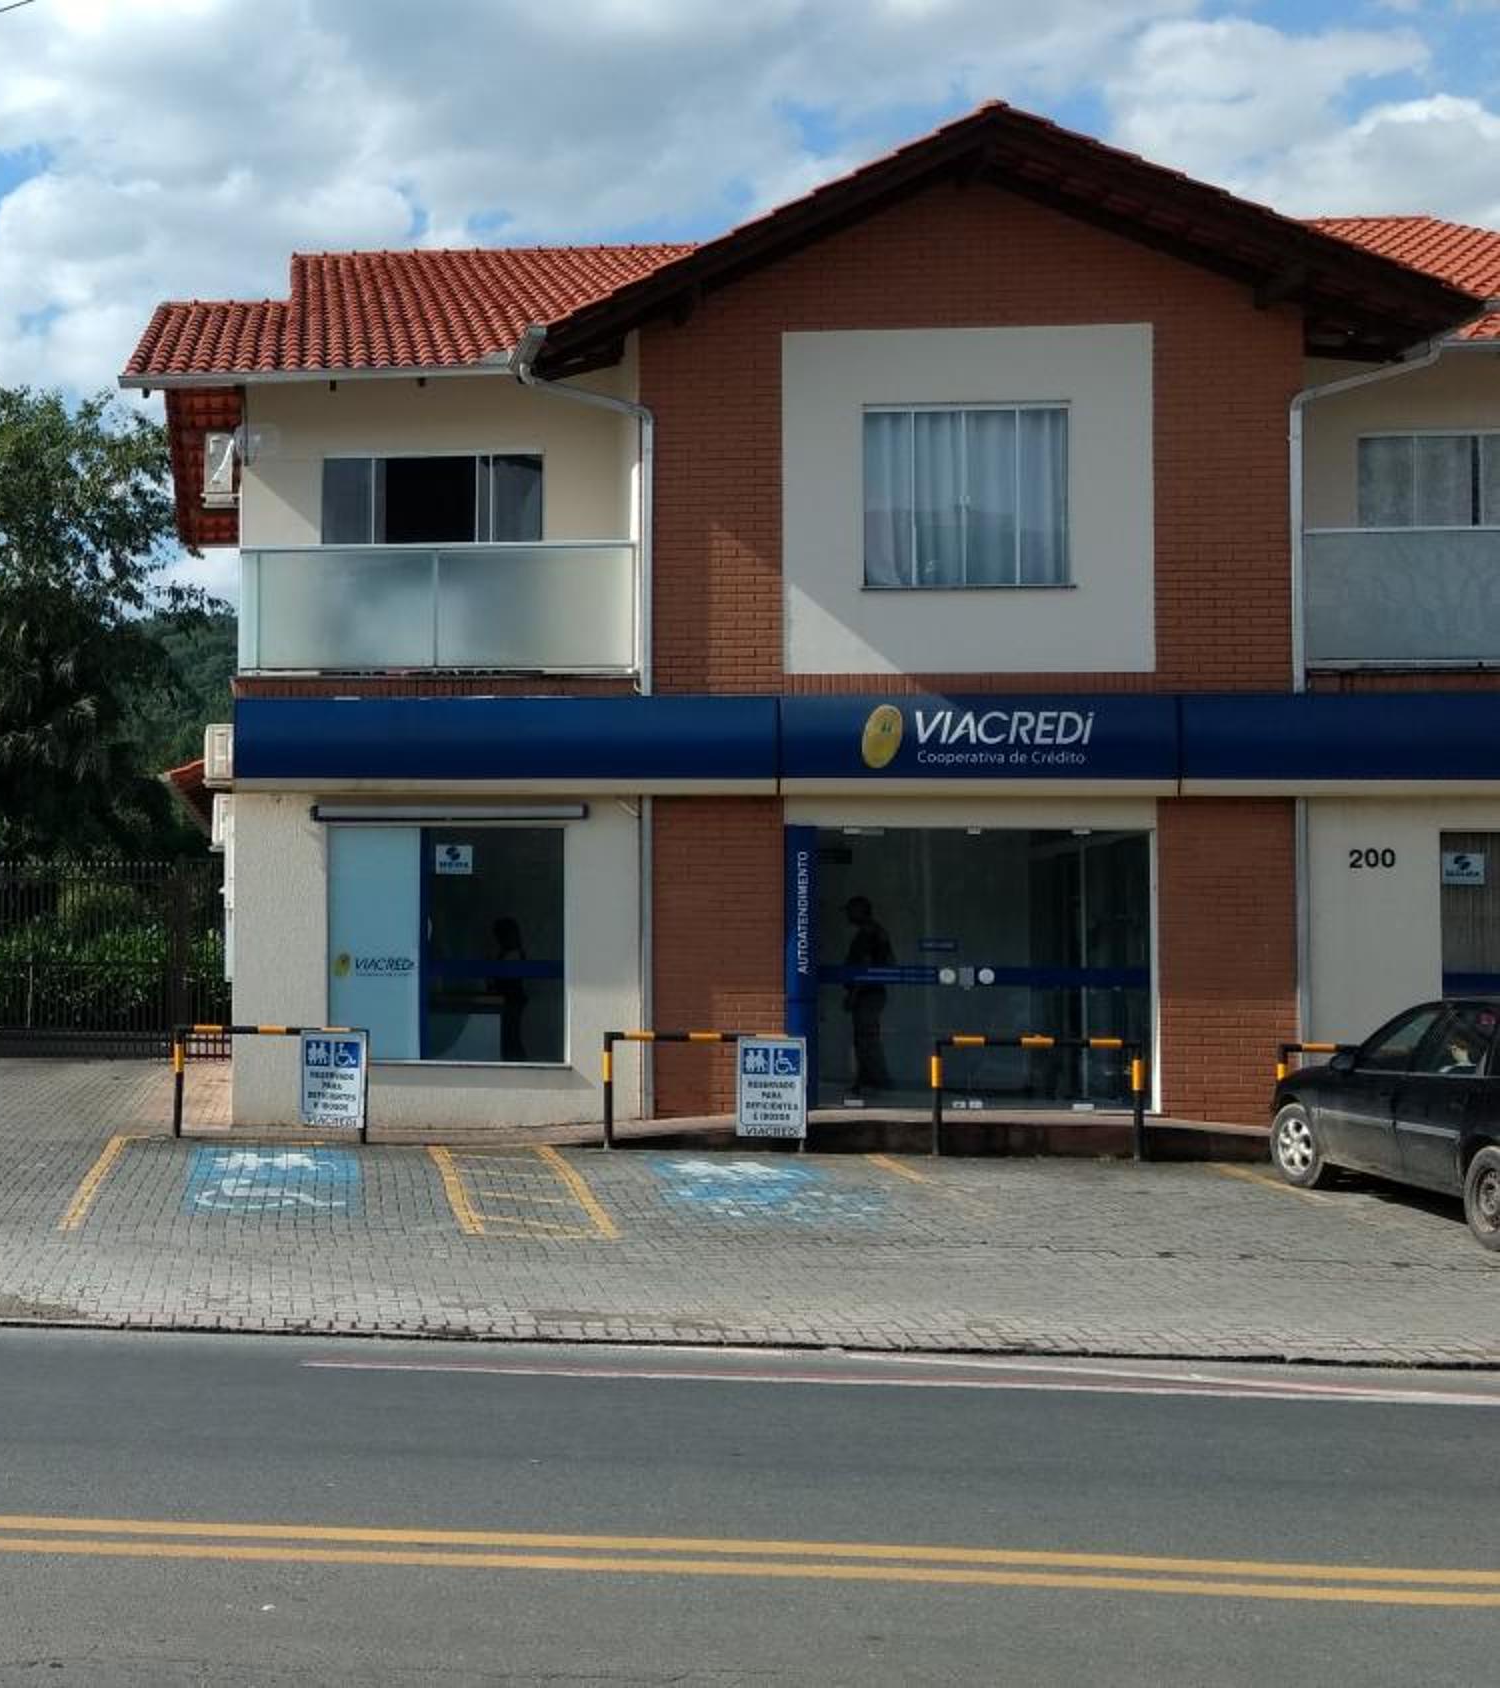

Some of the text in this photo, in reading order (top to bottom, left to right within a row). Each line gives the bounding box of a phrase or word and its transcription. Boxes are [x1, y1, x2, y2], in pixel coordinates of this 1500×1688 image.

[917, 749, 1086, 766] Cooperativa de Crédito
[1349, 848, 1396, 869] 200
[797, 851, 809, 974] AUTOATENDIMENTO
